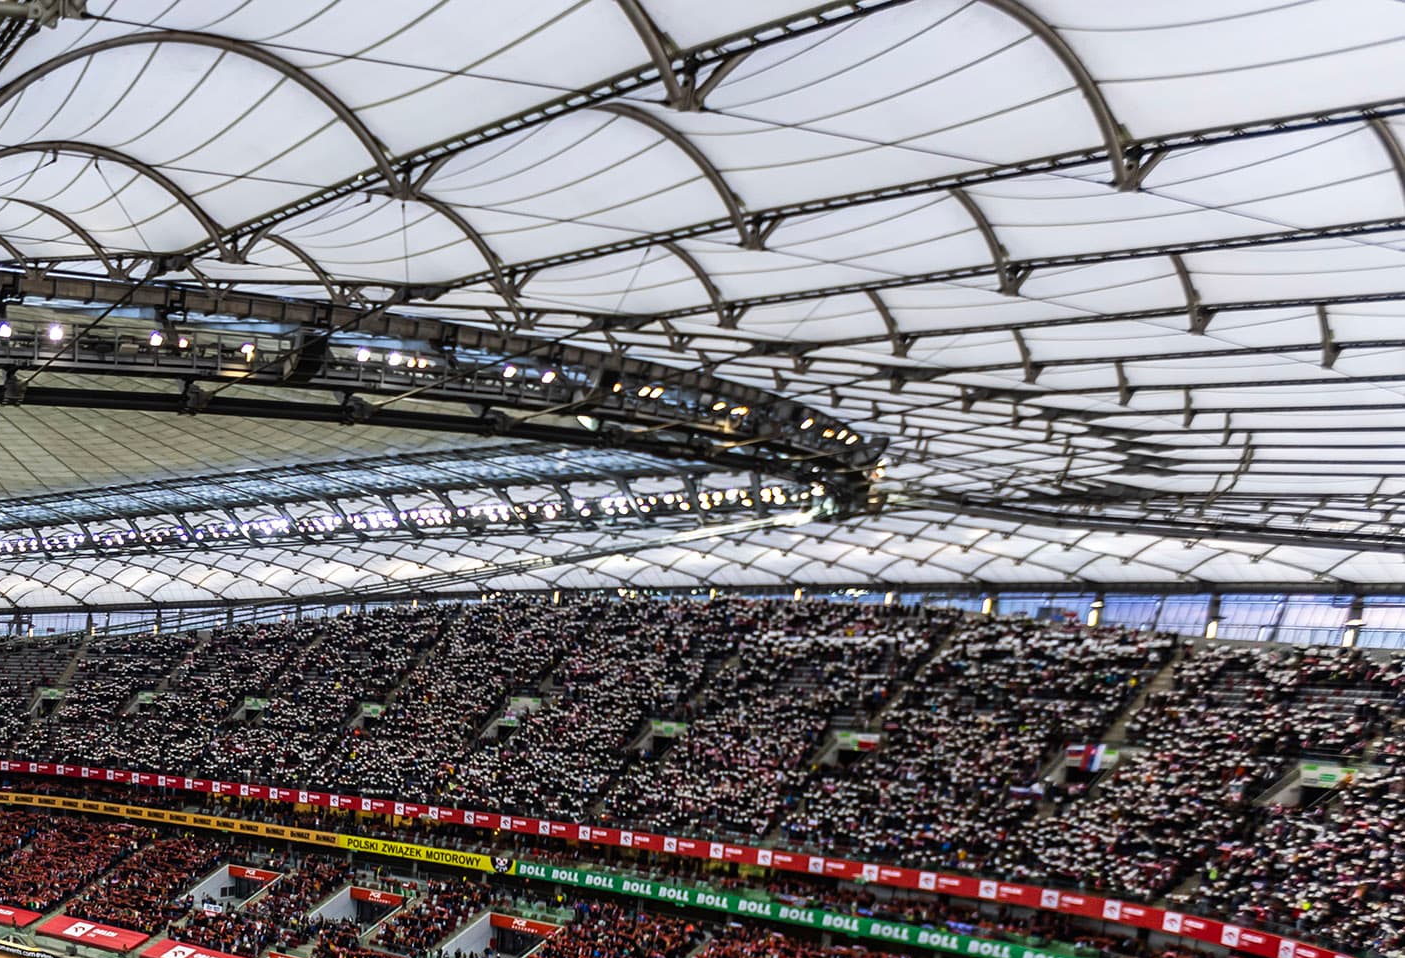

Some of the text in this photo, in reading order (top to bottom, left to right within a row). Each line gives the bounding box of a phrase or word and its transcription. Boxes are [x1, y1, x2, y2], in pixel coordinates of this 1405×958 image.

[347, 838, 481, 867] POLSKI ZWIĄZEK MOTOROWY
[520, 864, 546, 877] BOLL
[552, 870, 579, 883] BOLL
[585, 874, 614, 889] BOLL
[622, 880, 652, 896] BOLL
[658, 886, 689, 902] BOLL
[696, 892, 729, 909] BOLL
[738, 900, 772, 916] BOLL
[778, 906, 815, 924] BOLL
[822, 914, 859, 932] BOLL
[870, 923, 910, 941] BOLL
[918, 930, 959, 950] BOLL
[968, 940, 1012, 958] BOLL
